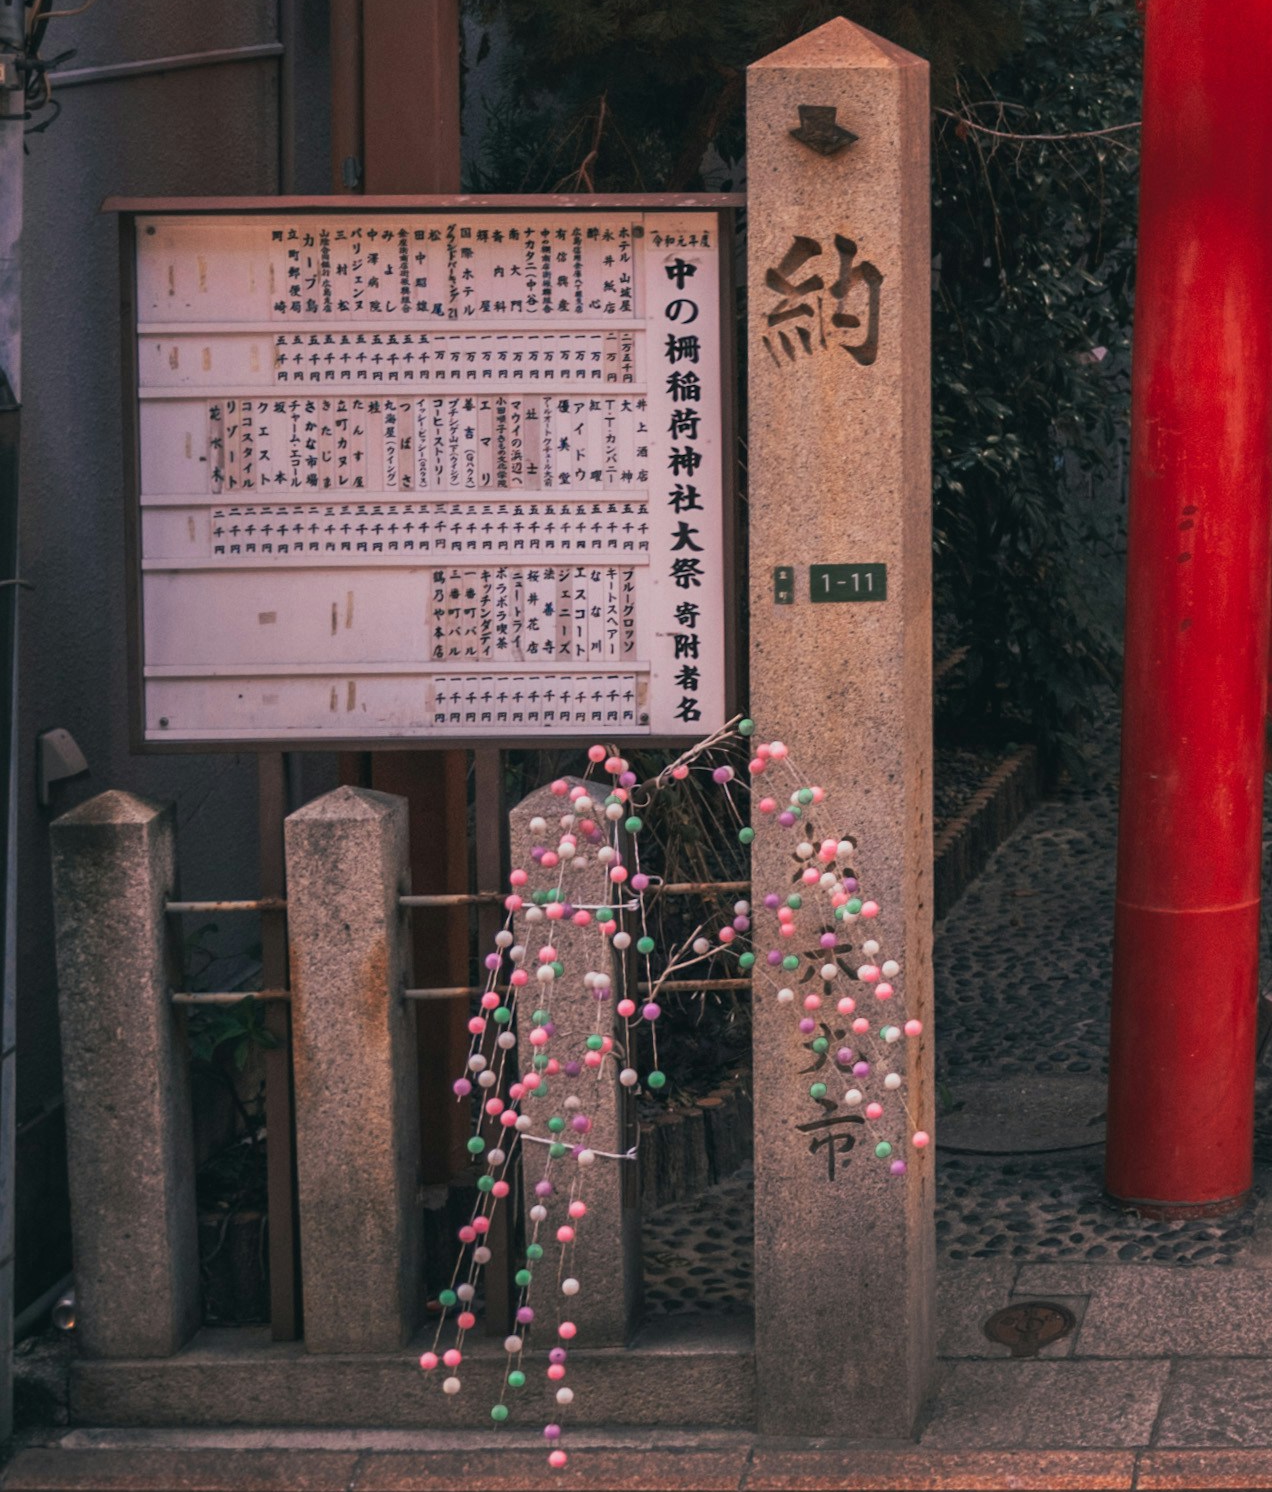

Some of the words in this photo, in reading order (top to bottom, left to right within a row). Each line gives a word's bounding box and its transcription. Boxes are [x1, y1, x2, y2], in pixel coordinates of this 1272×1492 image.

[651, 232, 712, 249] 令和元年度
[286, 228, 302, 314] 立町郵便局
[334, 229, 350, 312] 三村松
[380, 229, 397, 313] みよし
[427, 229, 446, 317] 松尾
[459, 227, 476, 316] 国際ホテル
[508, 227, 523, 313] 南大門
[762, 233, 886, 368] 納
[274, 335, 289, 382] 五千円
[307, 334, 321, 383] 五千円
[339, 334, 352, 380] 五千円
[370, 334, 384, 381] 五千円
[402, 334, 415, 380] 五千円
[433, 336, 446, 380] 一万円
[464, 335, 477, 380] 一万円
[496, 335, 509, 379] 一万円
[527, 335, 540, 380] 一万円
[559, 334, 571, 379] 一万円
[590, 334, 602, 379] 一万円
[605, 336, 618, 383] 二万円
[621, 333, 634, 384] 二万五千円
[241, 401, 255, 489] ココスタイル
[257, 401, 271, 486] クエスト
[304, 399, 319, 487] さかな市場
[320, 399, 333, 489] きたじま
[352, 399, 365, 489] たんす屋
[399, 402, 413, 490] つばさ
[432, 398, 444, 485] コーヒーストーリー
[479, 400, 492, 488] エマリ
[510, 400, 523, 485] マウイの浜辺へ
[573, 402, 586, 482] アイドウ
[620, 399, 634, 484] 大神
[635, 398, 649, 483] 井上酒店
[212, 510, 226, 555] 二千円
[244, 507, 257, 553] 二千円
[275, 506, 289, 554] 二千円
[307, 506, 320, 552] 二千円
[324, 506, 336, 552] 三千円
[354, 506, 369, 553] 三千円
[386, 505, 399, 551] 三千円
[417, 505, 430, 551] 三千円
[449, 505, 463, 552] 三千円
[480, 505, 494, 551] 三千円
[512, 504, 525, 550] 五千円
[527, 504, 541, 550] 五千円
[559, 504, 572, 550] 五千円
[590, 504, 603, 549] 五千円
[621, 504, 635, 551] 五千円
[637, 503, 650, 552] 五千円
[821, 572, 874, 593] 1-11
[447, 569, 462, 657] 三番町バル
[463, 571, 478, 656] 一番町バル
[526, 569, 540, 655] 桜井花店
[558, 567, 572, 655] ジェニーズ
[573, 567, 587, 656] エスコート
[605, 567, 619, 655] キートスヘアー
[434, 677, 447, 724] 一千円
[464, 676, 478, 723] 一千円
[496, 676, 509, 722] 一千円
[527, 676, 540, 722] 一千円
[559, 676, 572, 722] 一千円
[590, 675, 604, 722] 一千円
[605, 674, 621, 722] 一千円
[622, 673, 635, 723] 一千円
